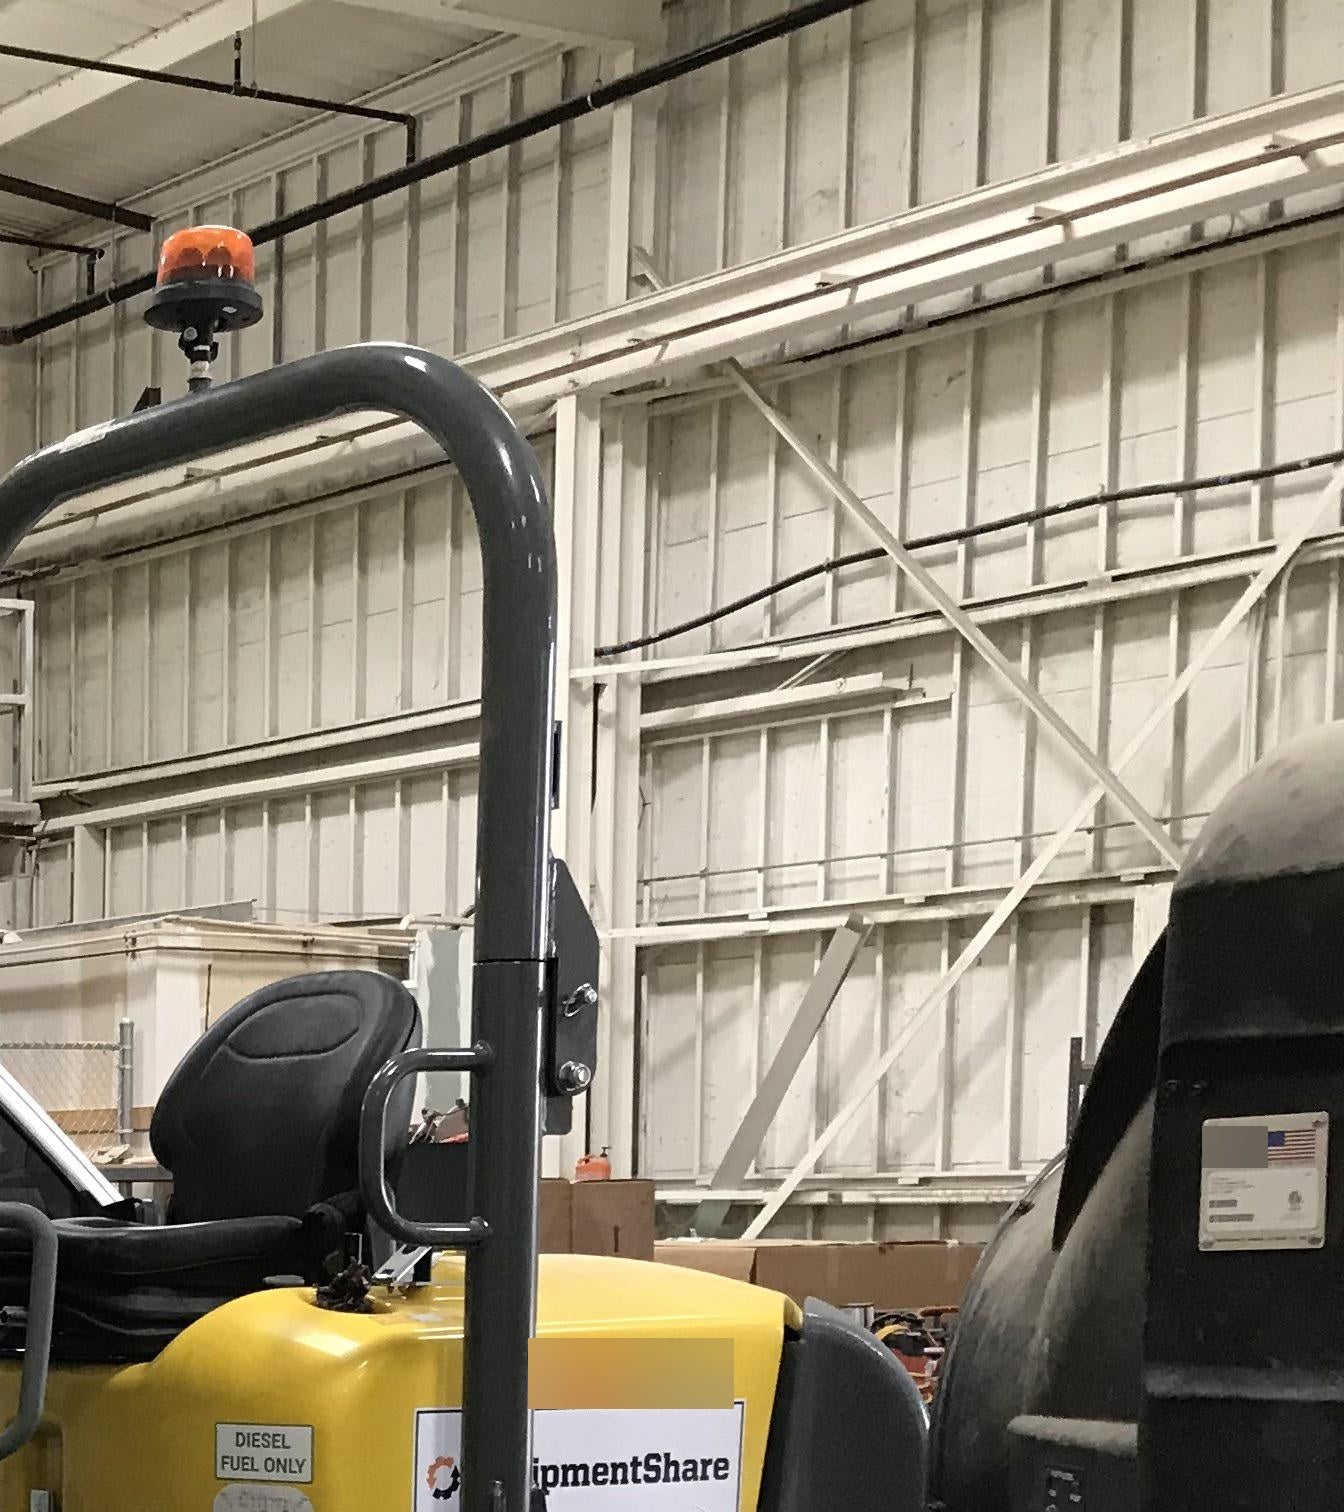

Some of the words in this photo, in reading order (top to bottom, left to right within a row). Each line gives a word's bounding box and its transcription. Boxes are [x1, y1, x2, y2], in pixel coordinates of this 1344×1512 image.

[234, 1431, 292, 1450] DIESEL
[221, 1455, 259, 1472] FUEL
[263, 1457, 307, 1474] ONLY
[532, 1452, 730, 1496] ipmentShare
